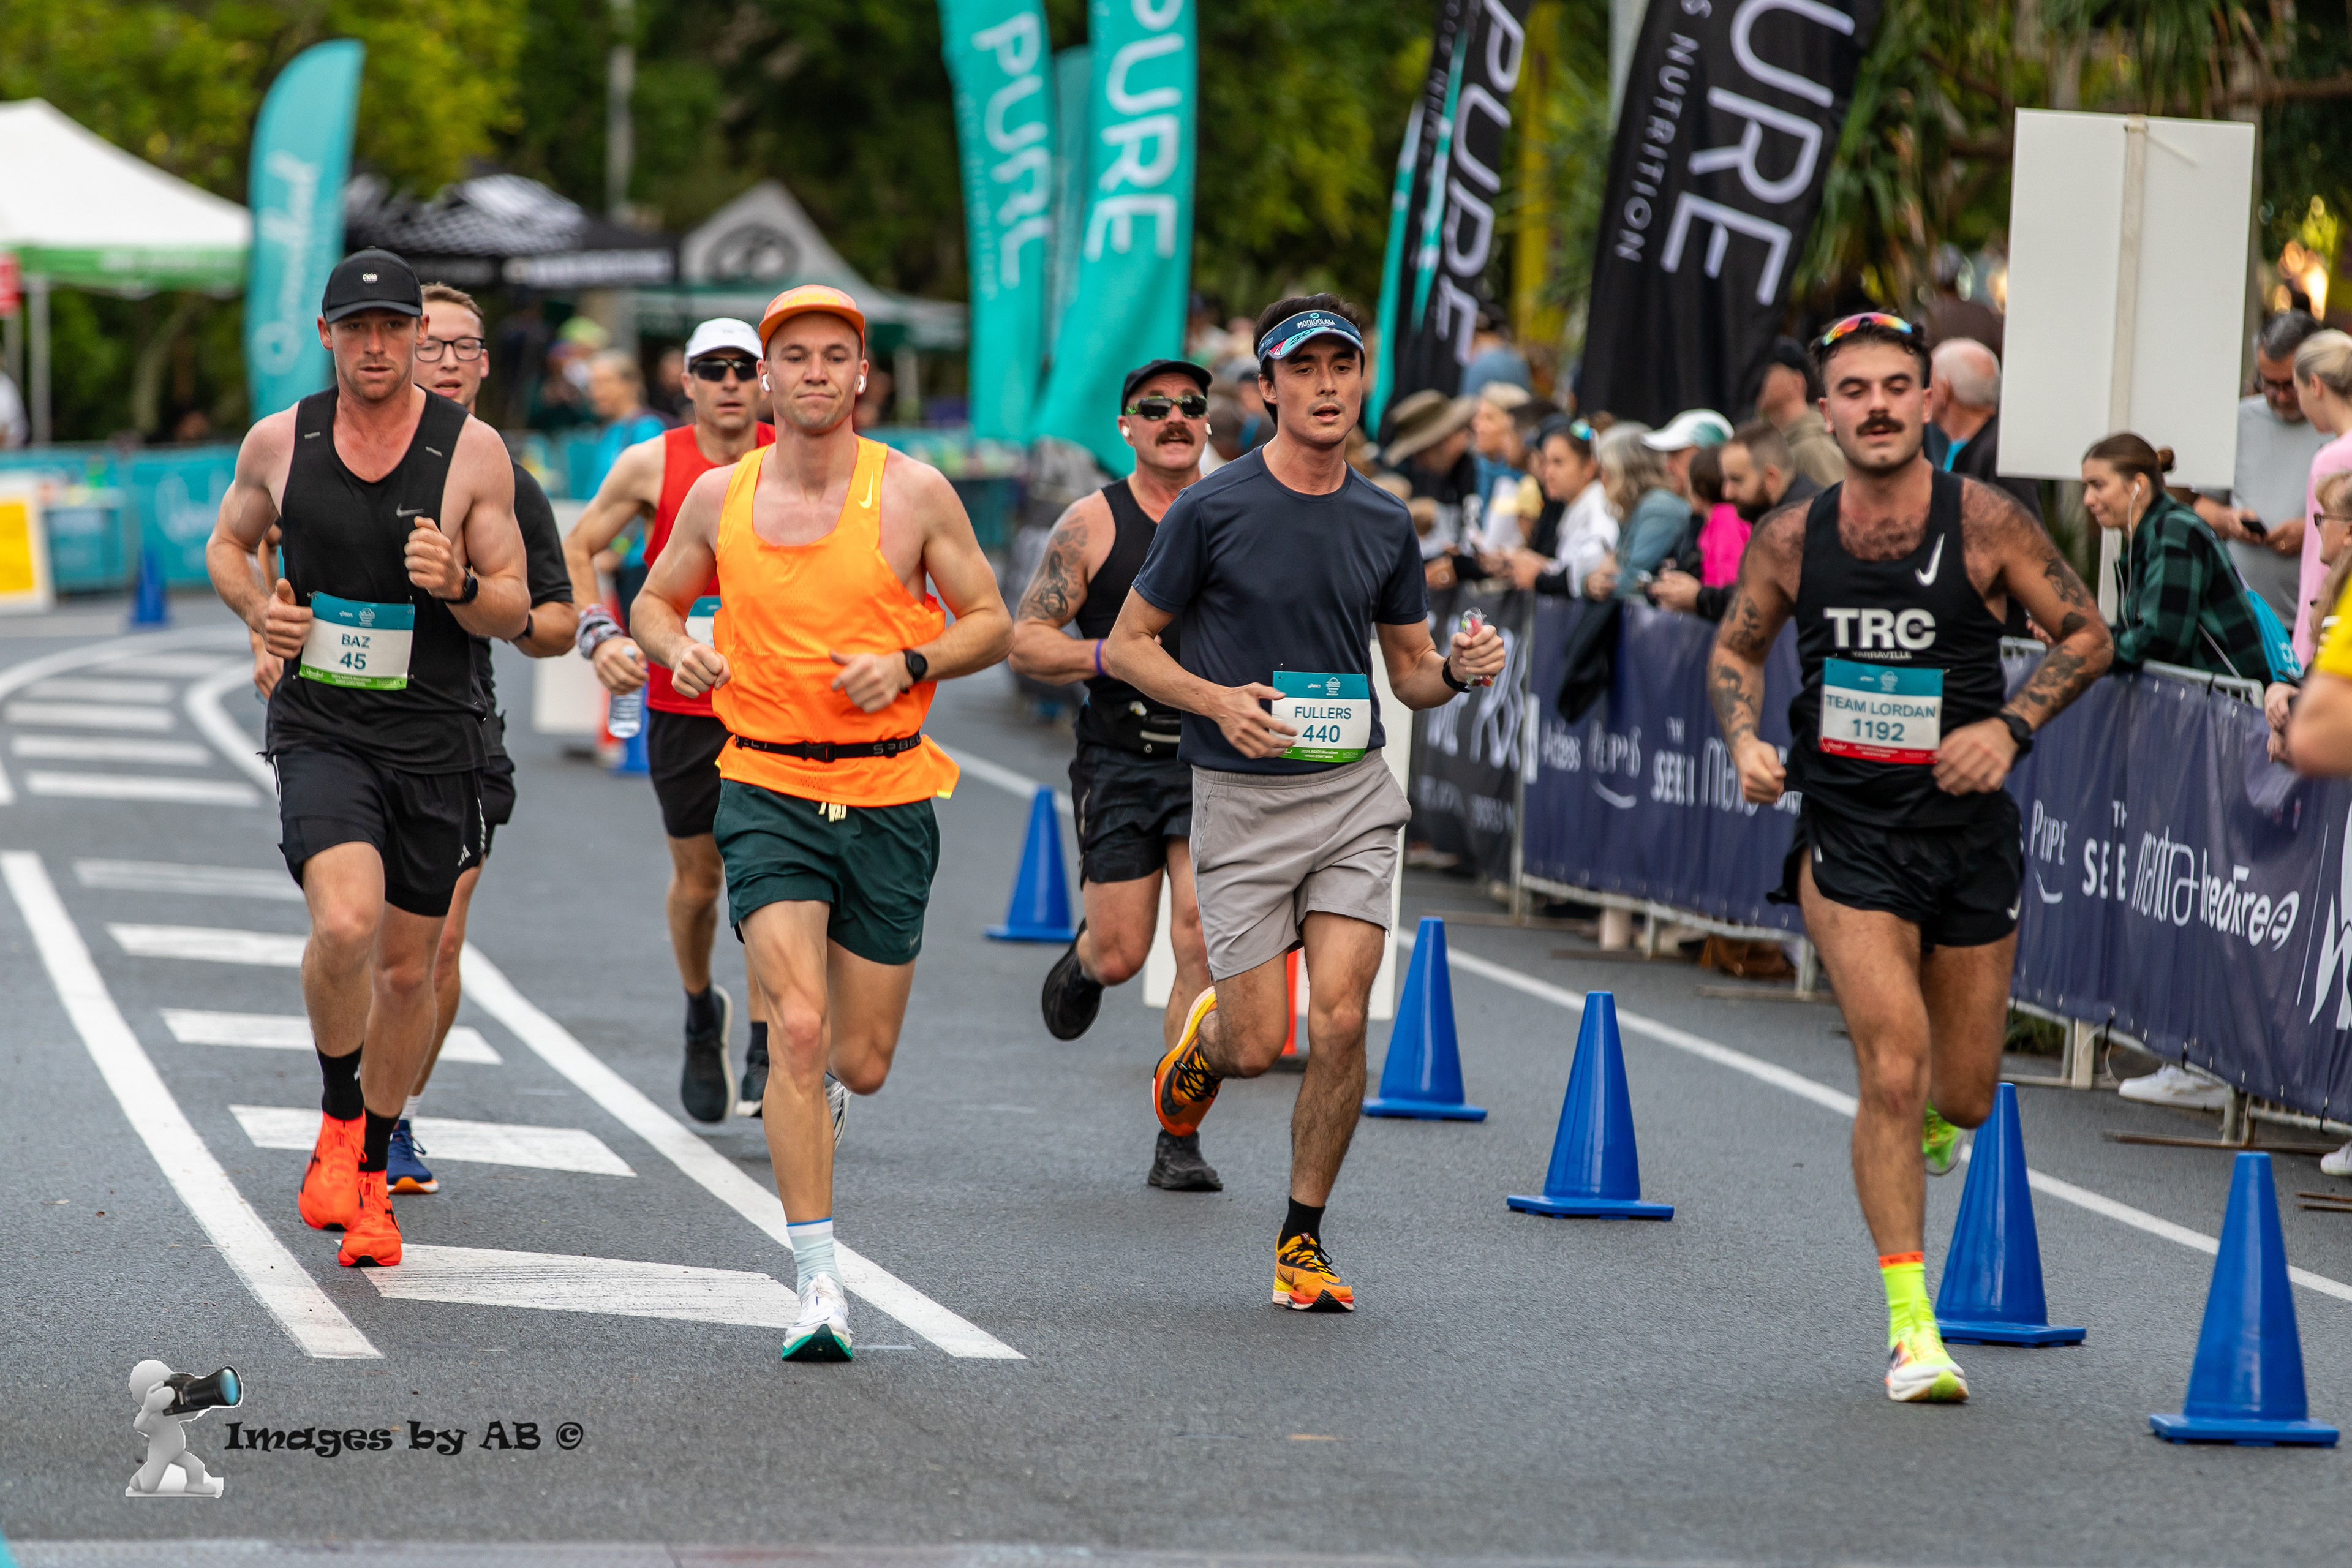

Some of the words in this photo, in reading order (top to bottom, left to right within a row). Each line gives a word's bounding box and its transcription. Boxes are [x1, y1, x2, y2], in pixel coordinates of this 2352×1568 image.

[1614, 32, 1700, 262] NUTRITION
[783, 293, 839, 309] HOKA
[1297, 318, 1336, 329] MOOLOOLABA
[1823, 607, 1936, 650] TRC
[342, 633, 371, 649] BAZ
[339, 652, 366, 670] 45
[1295, 706, 1351, 720] FULLERS
[1826, 694, 1866, 713] TEAM
[1871, 701, 1936, 718] LORDAN
[1302, 725, 1340, 742] 440
[1853, 718, 1905, 742] 1192
